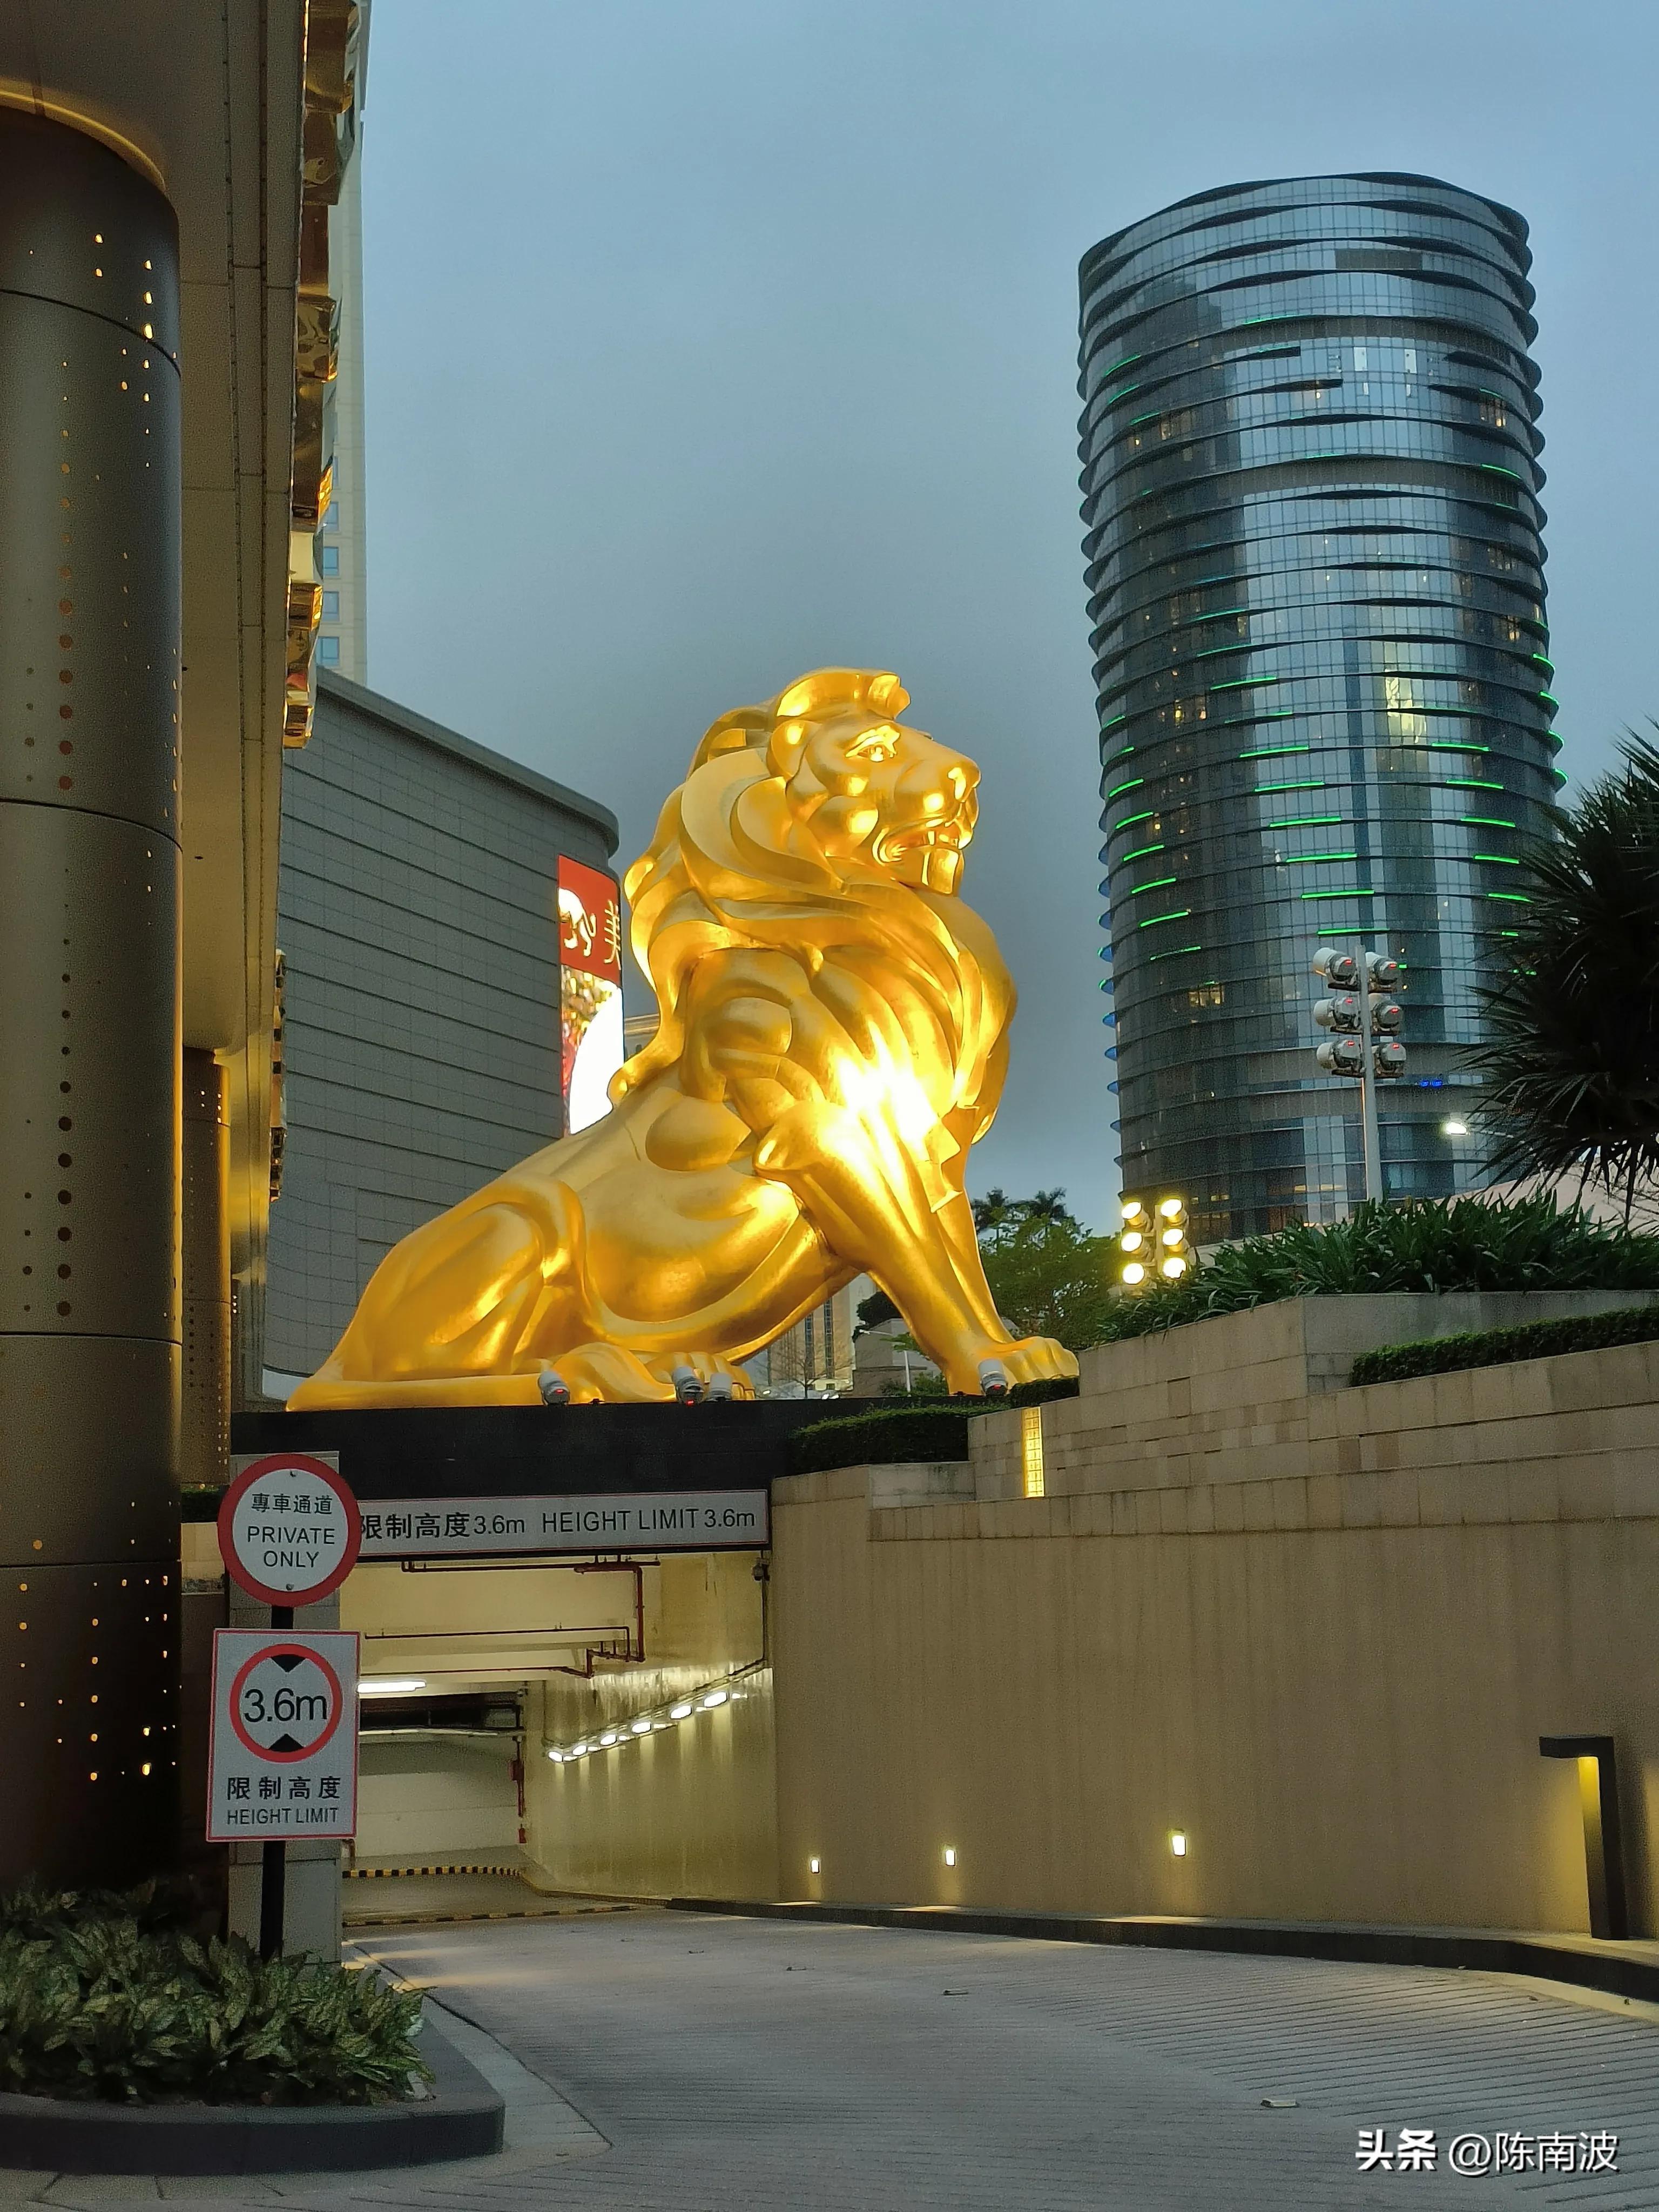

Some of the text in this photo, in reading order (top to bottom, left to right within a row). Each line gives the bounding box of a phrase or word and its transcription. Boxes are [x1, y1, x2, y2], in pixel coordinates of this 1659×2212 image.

[252, 1493, 333, 1514] 專車通道
[543, 1510, 630, 1533] HEIGHT
[639, 1508, 699, 1529] LIMIT
[704, 1509, 755, 1528] 3.6m
[247, 1526, 335, 1545] PRIVATE
[264, 1550, 320, 1567] ONLY
[244, 1688, 327, 1722] 3.6m
[227, 1776, 341, 1800] 限制高度
[227, 1807, 338, 1825] HEIGHT LIMIT
